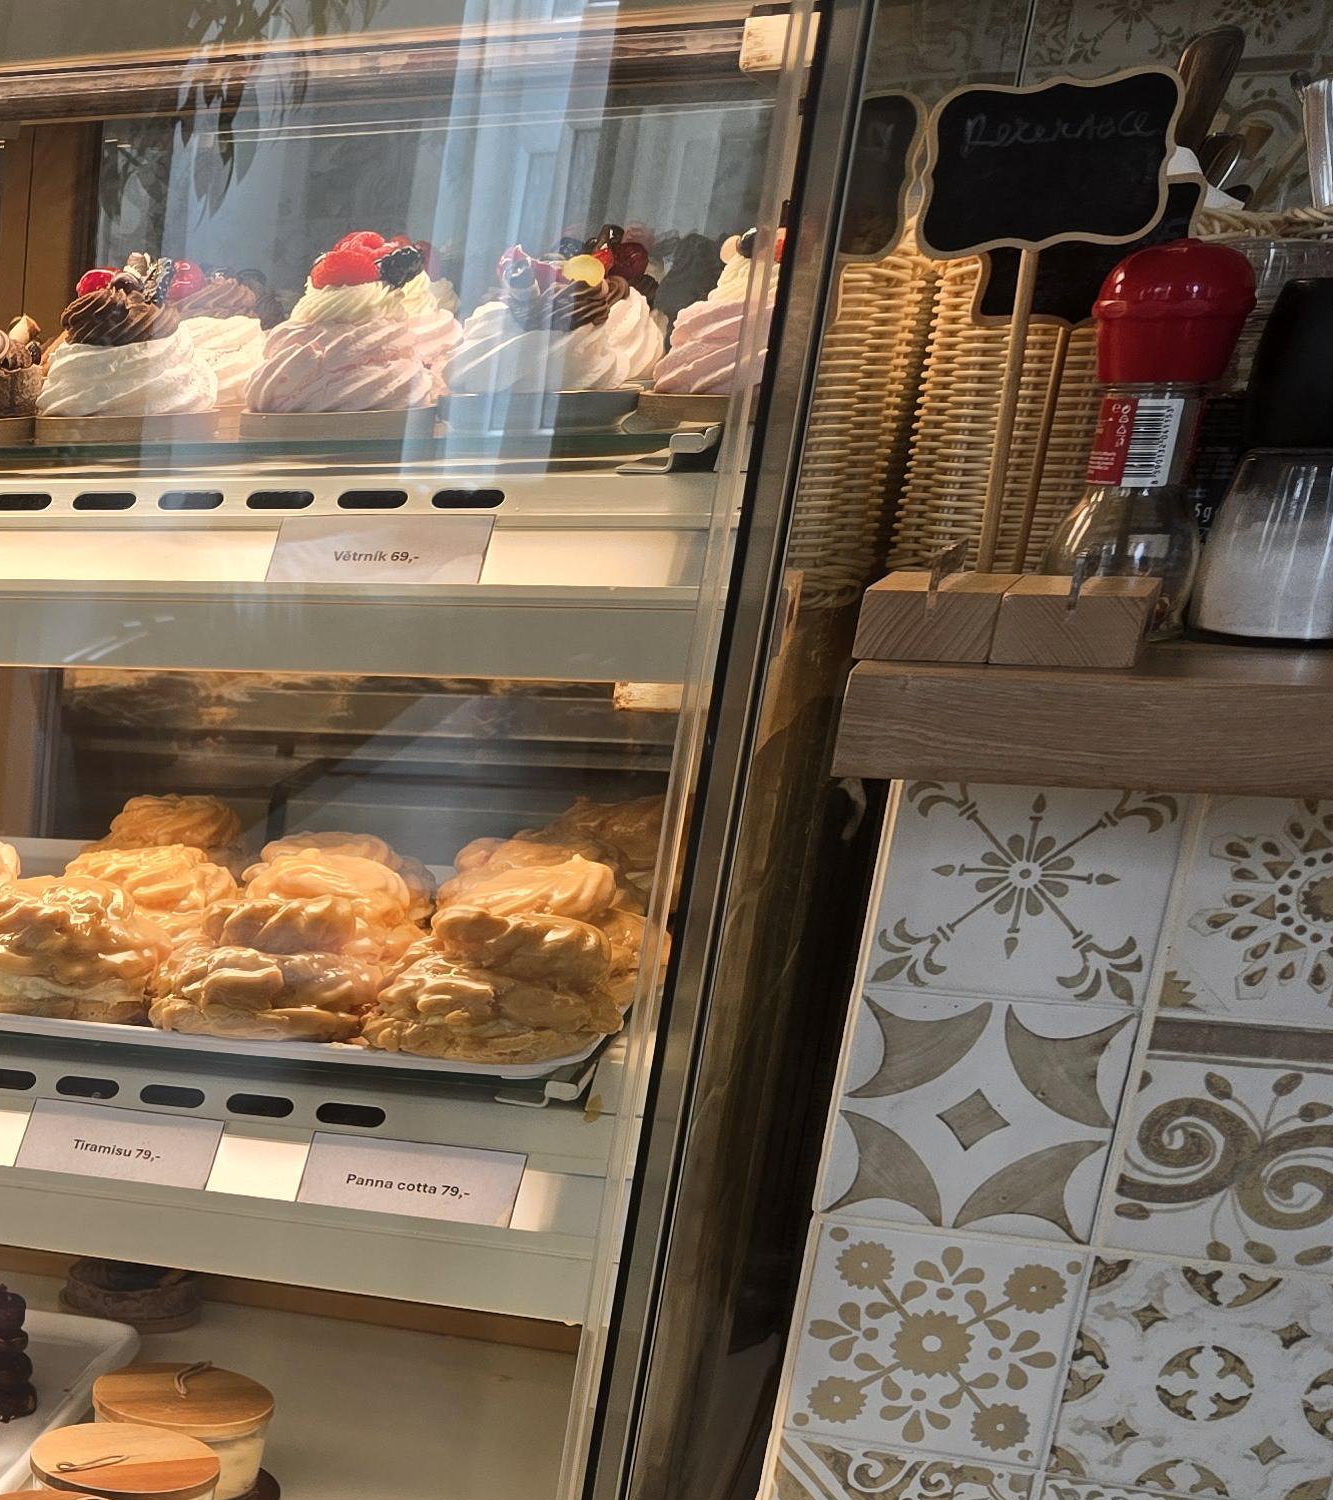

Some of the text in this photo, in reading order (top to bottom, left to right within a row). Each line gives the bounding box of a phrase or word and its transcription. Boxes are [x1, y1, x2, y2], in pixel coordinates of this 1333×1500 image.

[334, 550, 420, 564] Větrník 69,-
[73, 1138, 161, 1162] Tiramisu 79,-
[346, 1173, 470, 1200] Panna cotta 79,-
